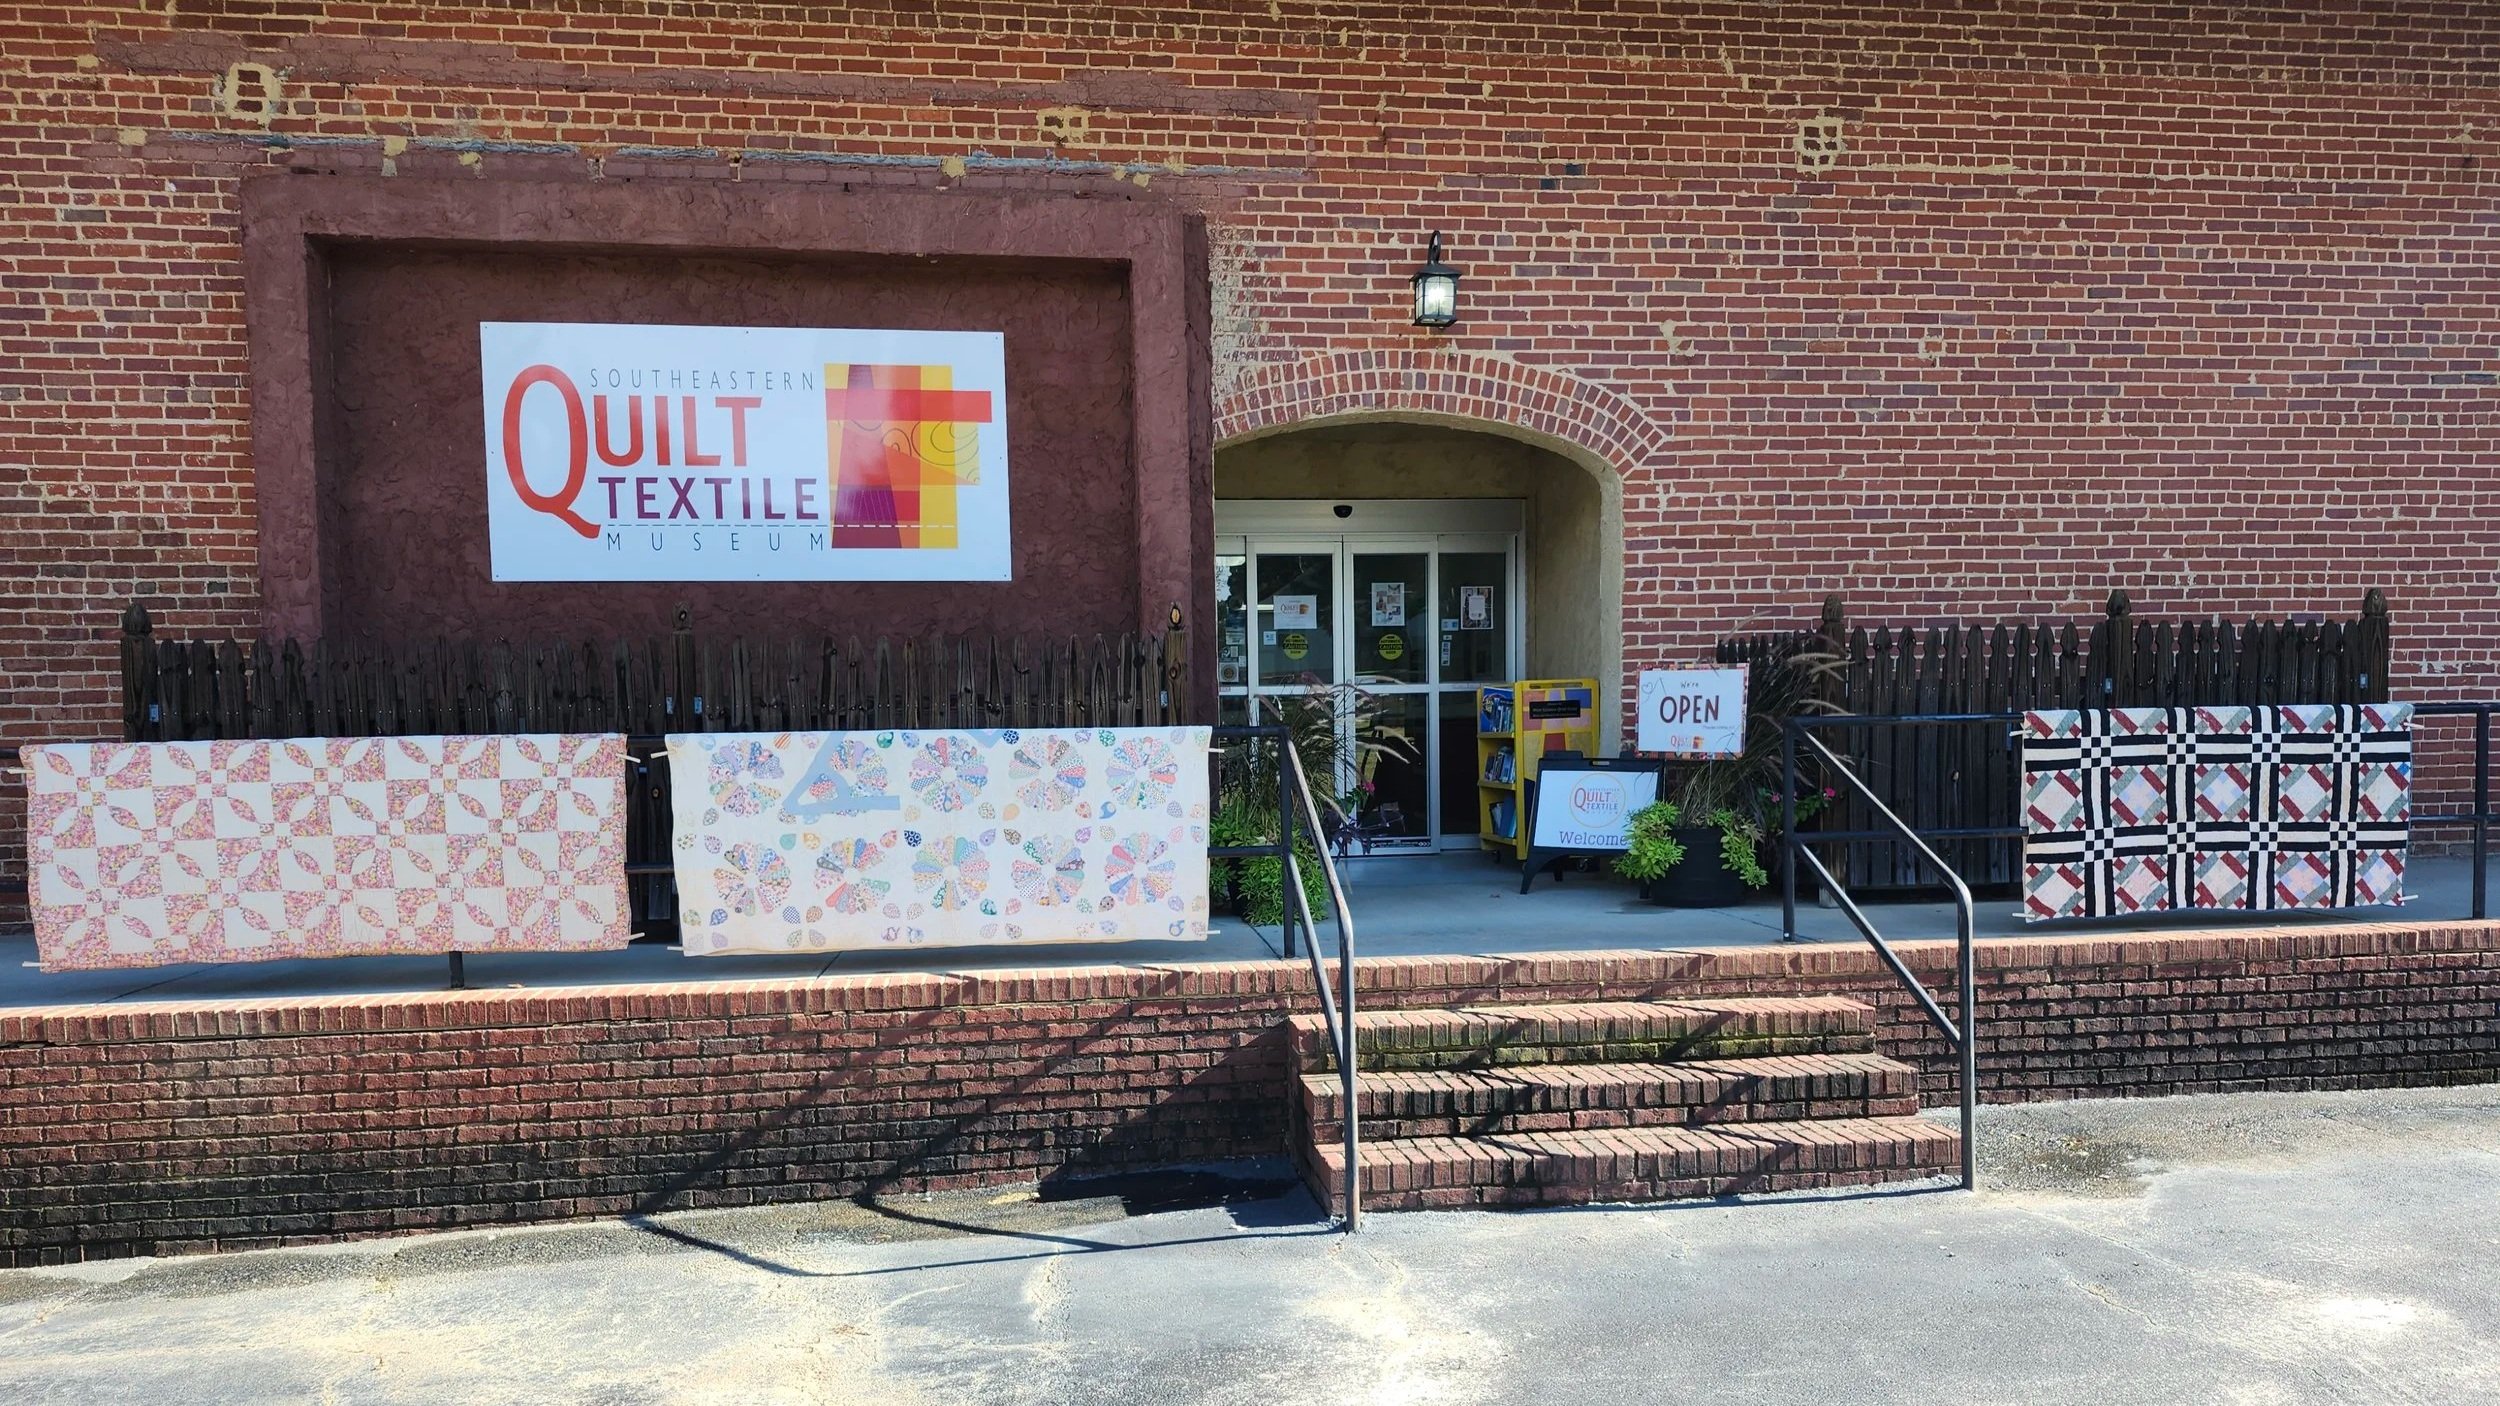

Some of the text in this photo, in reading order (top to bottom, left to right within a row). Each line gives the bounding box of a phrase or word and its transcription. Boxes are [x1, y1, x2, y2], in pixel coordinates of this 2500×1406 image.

[590, 368, 815, 392] SOUTHEASTERN
[502, 363, 763, 539] QUILT
[598, 476, 819, 521] TEXTILE
[606, 532, 824, 552] MUSEUM
[1660, 695, 1719, 724] OPEN
[1574, 787, 1612, 812] QUILT
[1559, 831, 1628, 846] Welcome
